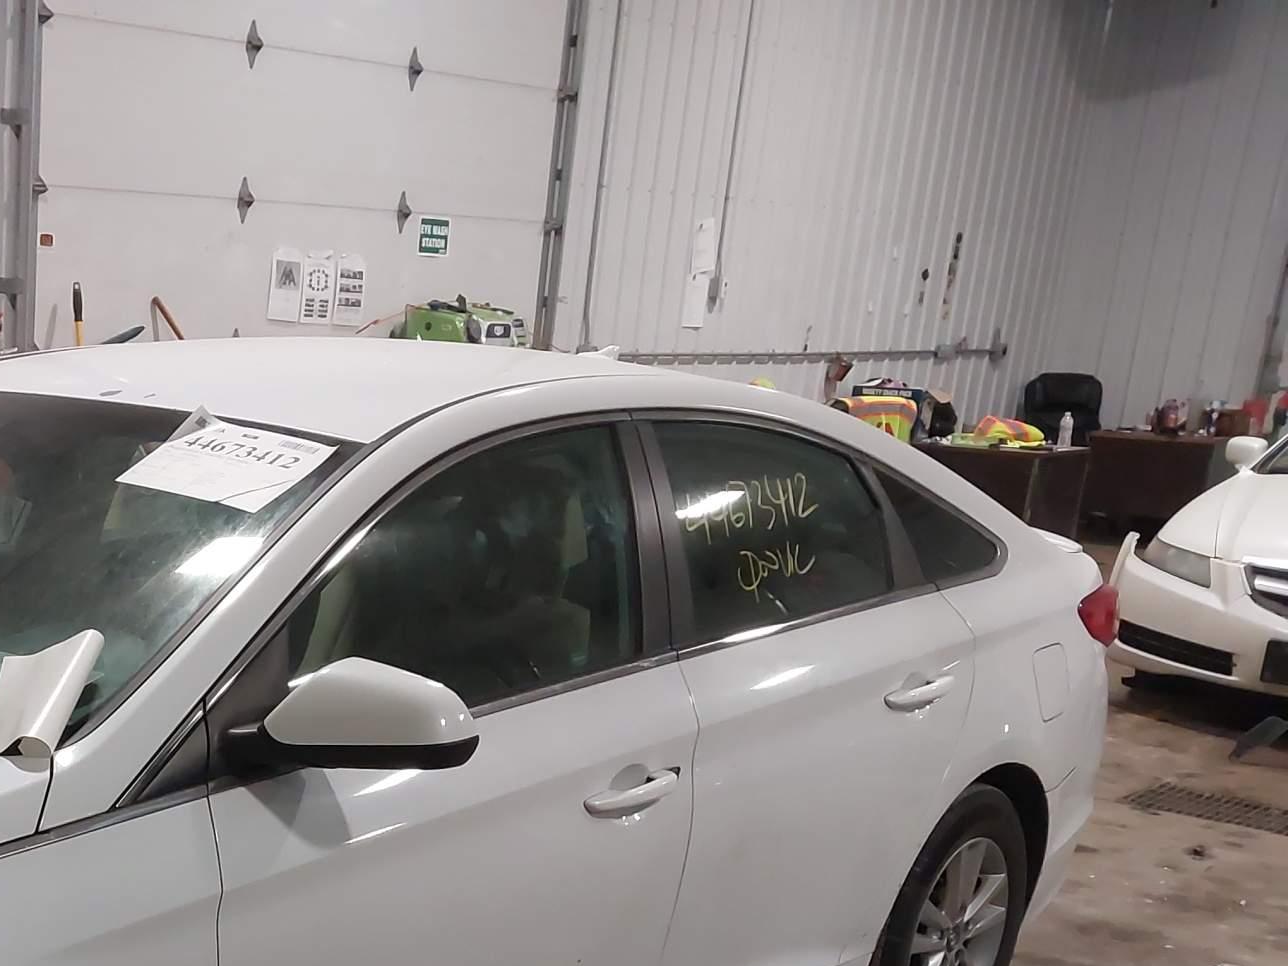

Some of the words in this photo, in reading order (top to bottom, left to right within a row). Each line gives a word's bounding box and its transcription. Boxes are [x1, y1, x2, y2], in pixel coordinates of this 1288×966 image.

[421, 224, 432, 235] EYE
[421, 237, 445, 249] STATION
[184, 436, 301, 469] 44673412
